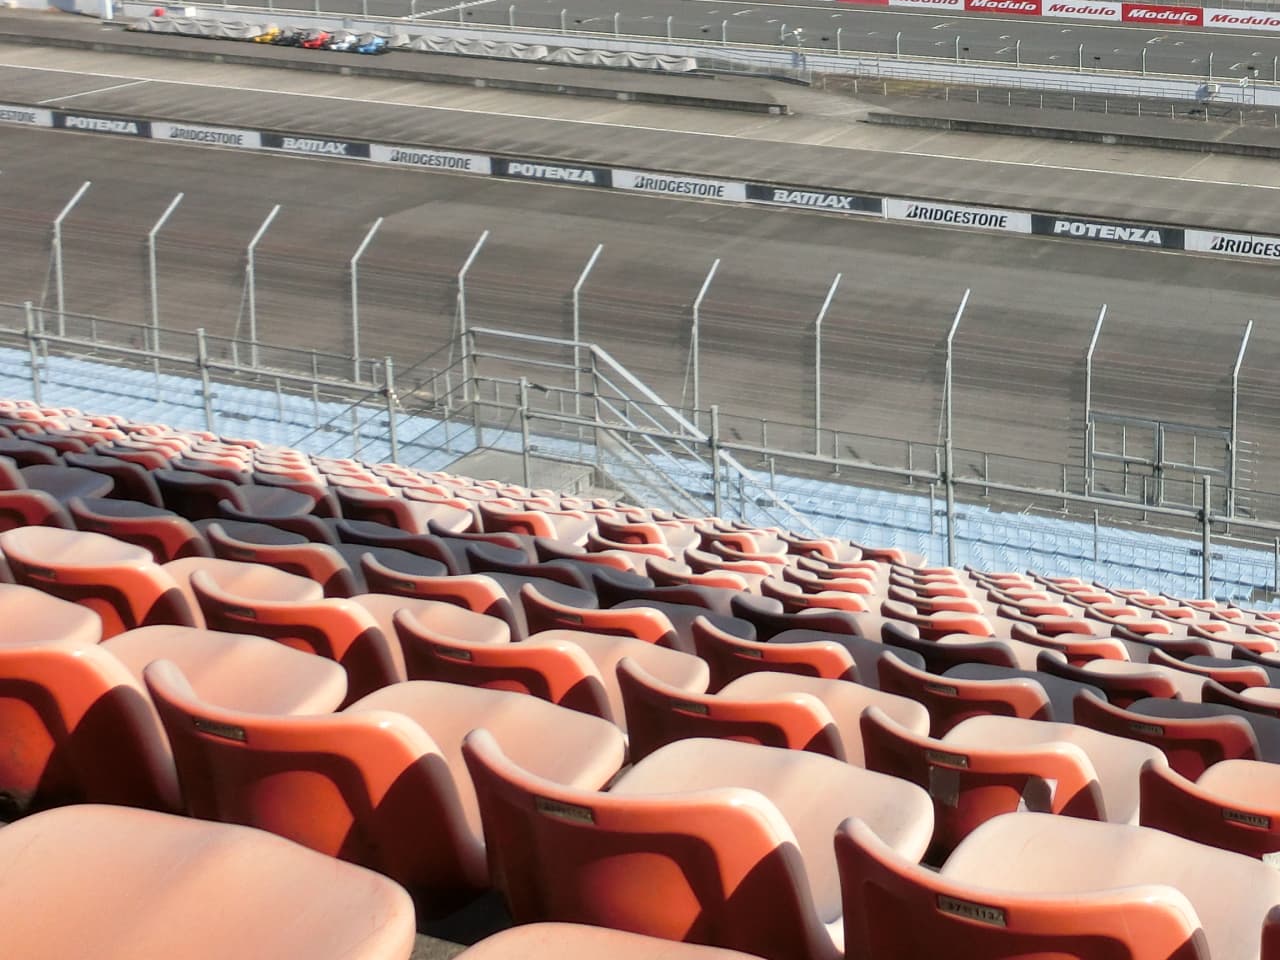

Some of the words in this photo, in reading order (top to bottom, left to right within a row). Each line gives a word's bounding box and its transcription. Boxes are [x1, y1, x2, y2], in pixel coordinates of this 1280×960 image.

[1048, 3, 1116, 16] Modulo
[1127, 9, 1198, 22] Modulo
[66, 116, 138, 134] POTENZA
[170, 126, 243, 145] BRIDGESTONE
[390, 149, 471, 170] BRIDGESTONE
[508, 162, 595, 183] POTENZA
[633, 175, 724, 198] BRIDGESTONE
[905, 203, 1008, 228] BRIDGESTONE
[1053, 220, 1162, 244] POTENZA
